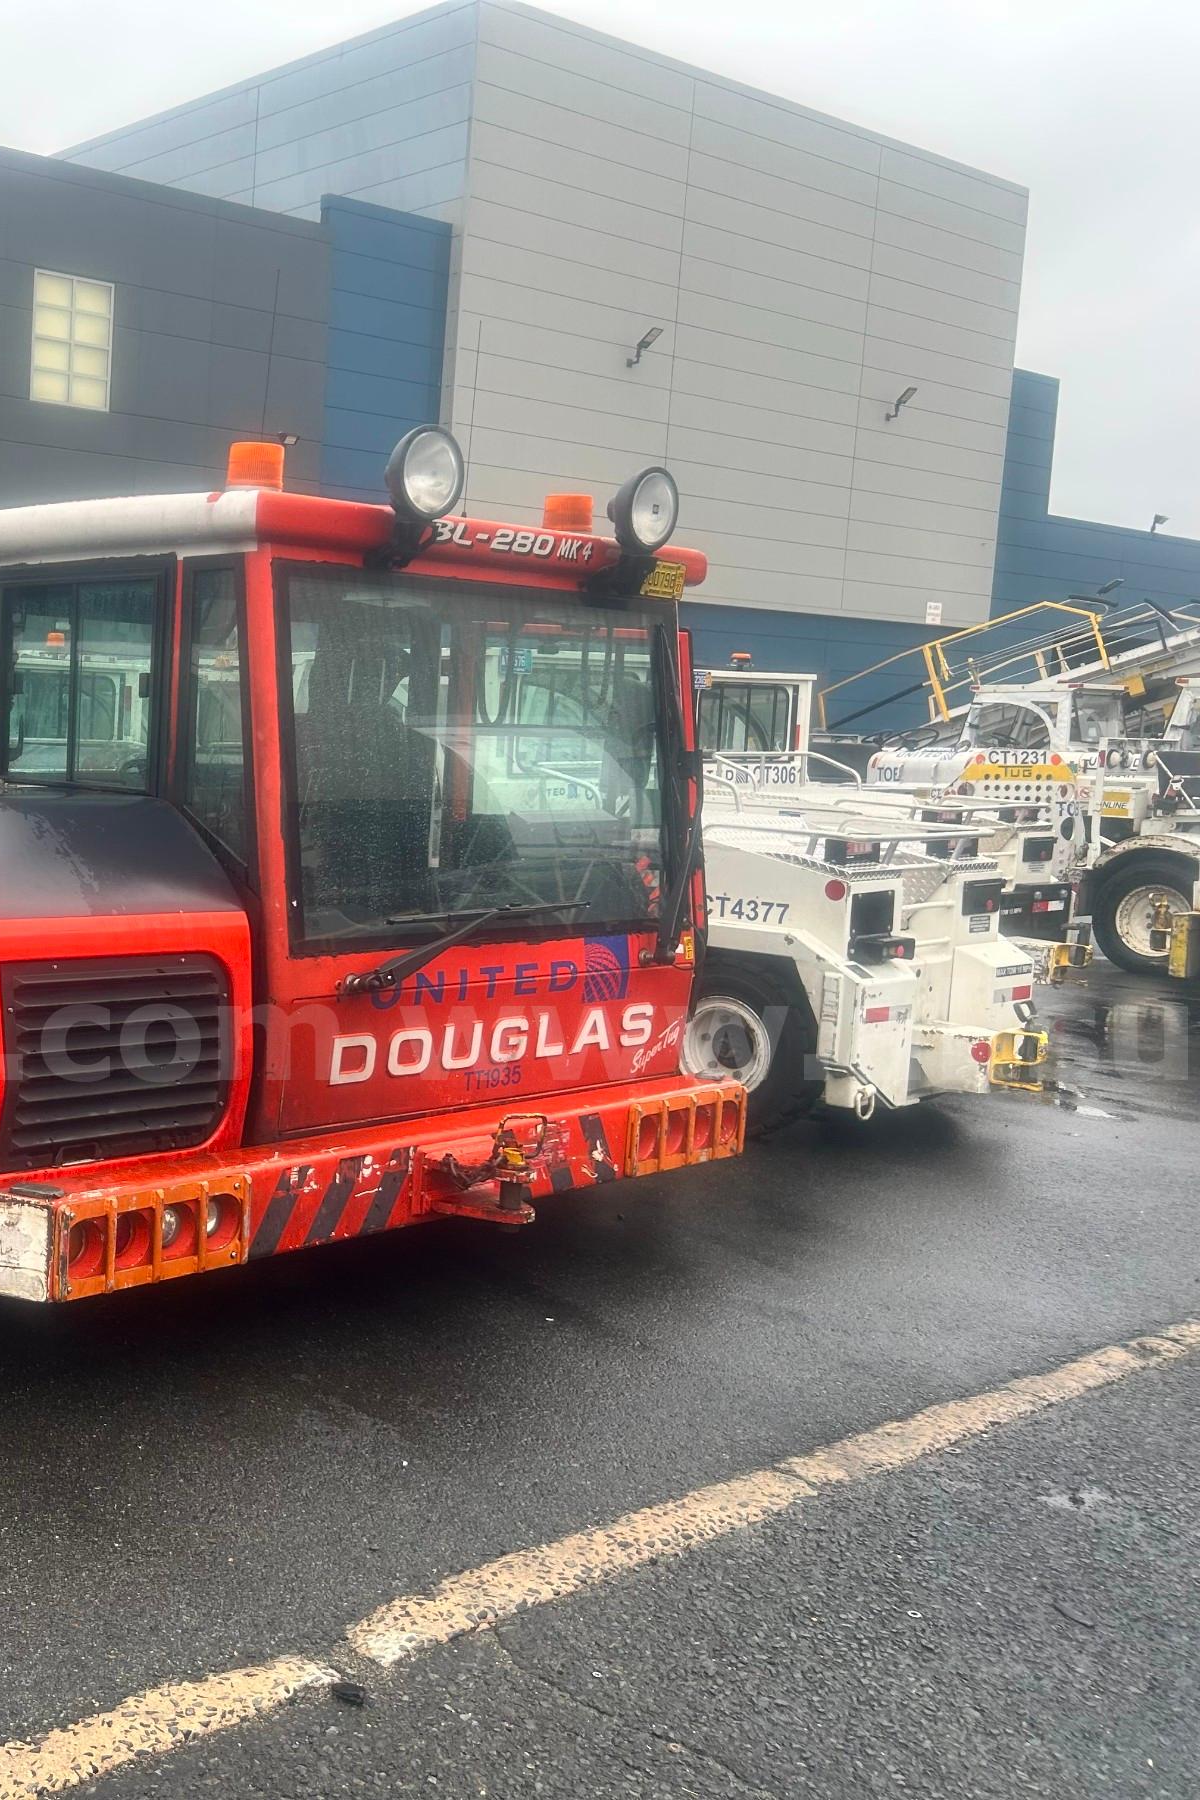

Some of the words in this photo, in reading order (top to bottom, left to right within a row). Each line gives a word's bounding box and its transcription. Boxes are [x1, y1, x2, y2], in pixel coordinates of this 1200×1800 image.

[988, 750, 1048, 765] CT1231
[753, 766, 801, 784] CT306
[998, 766, 1033, 778] TUG
[705, 894, 790, 924] CT4377
[371, 960, 578, 1010] UNITED
[329, 1002, 653, 1086] DOUGLAS
[464, 1065, 522, 1091] TT1935
